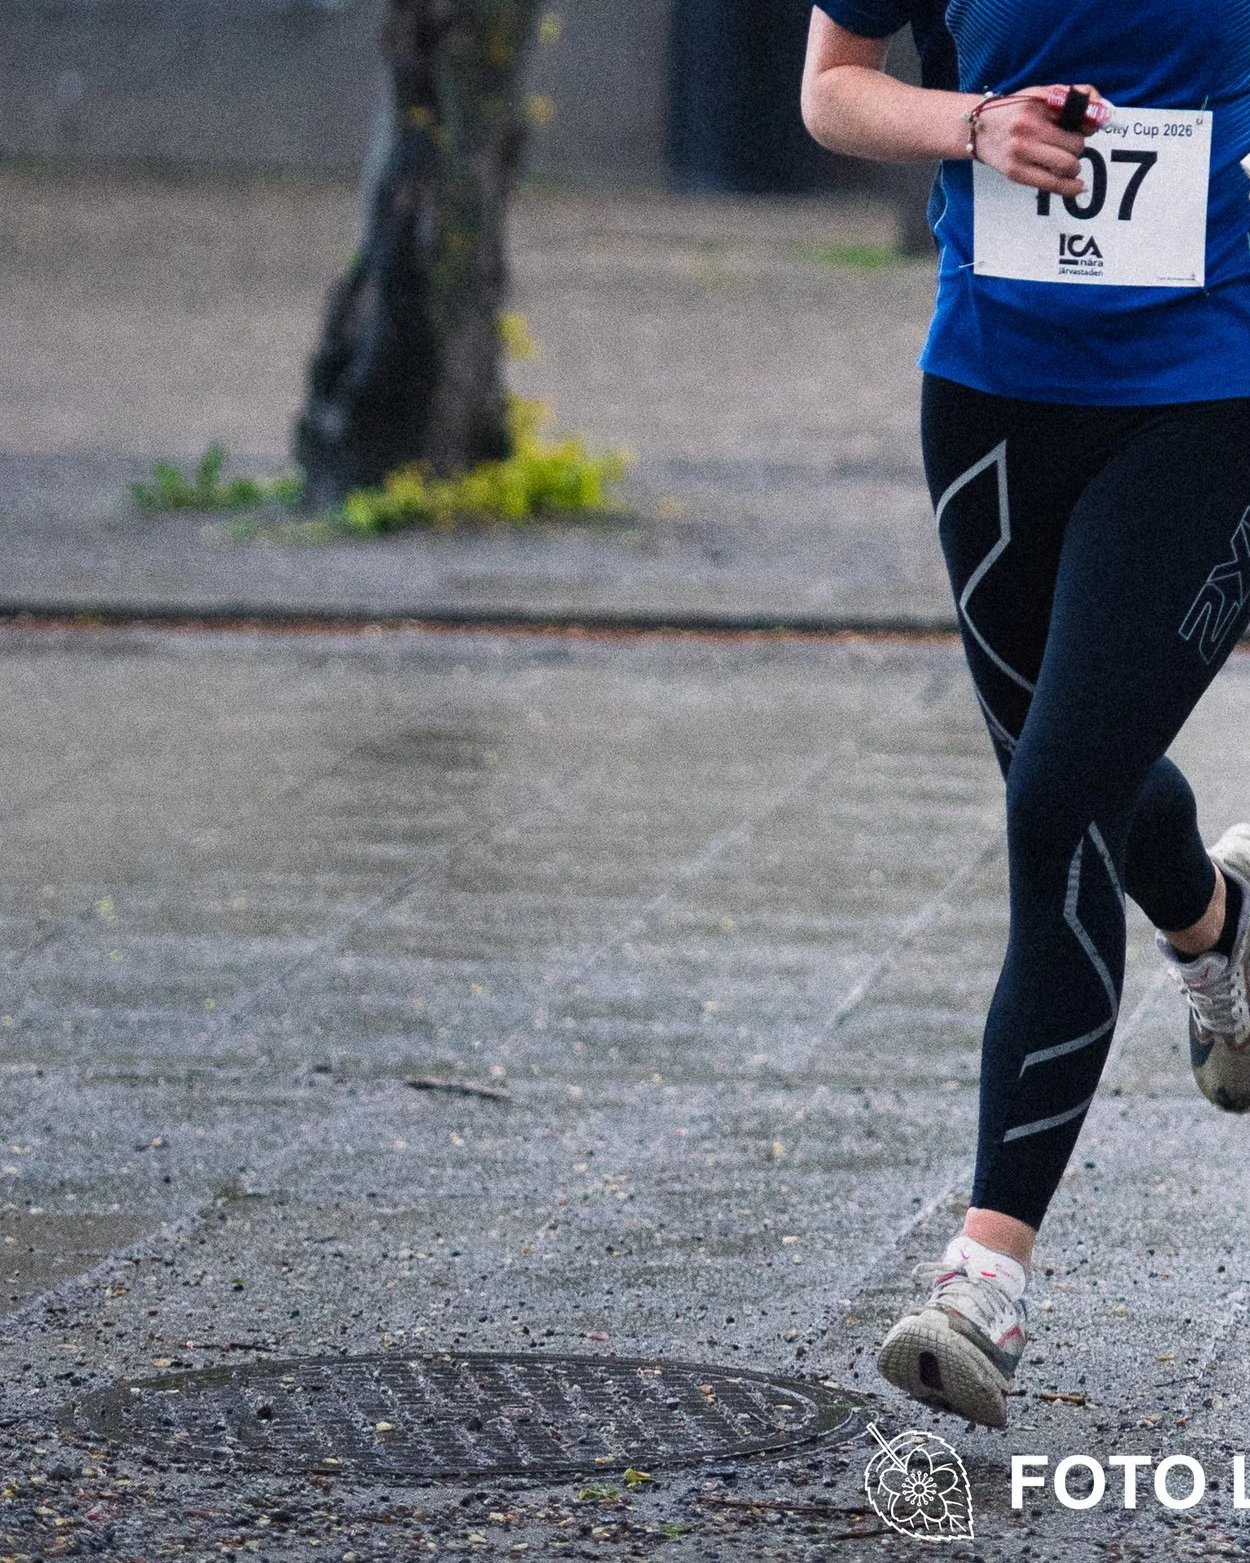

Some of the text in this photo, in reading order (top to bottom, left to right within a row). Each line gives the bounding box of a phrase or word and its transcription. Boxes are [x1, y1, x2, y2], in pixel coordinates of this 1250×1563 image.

[1134, 123, 1159, 139] Cup
[1163, 124, 1193, 137] 2026
[1059, 233, 1103, 259] ICA
